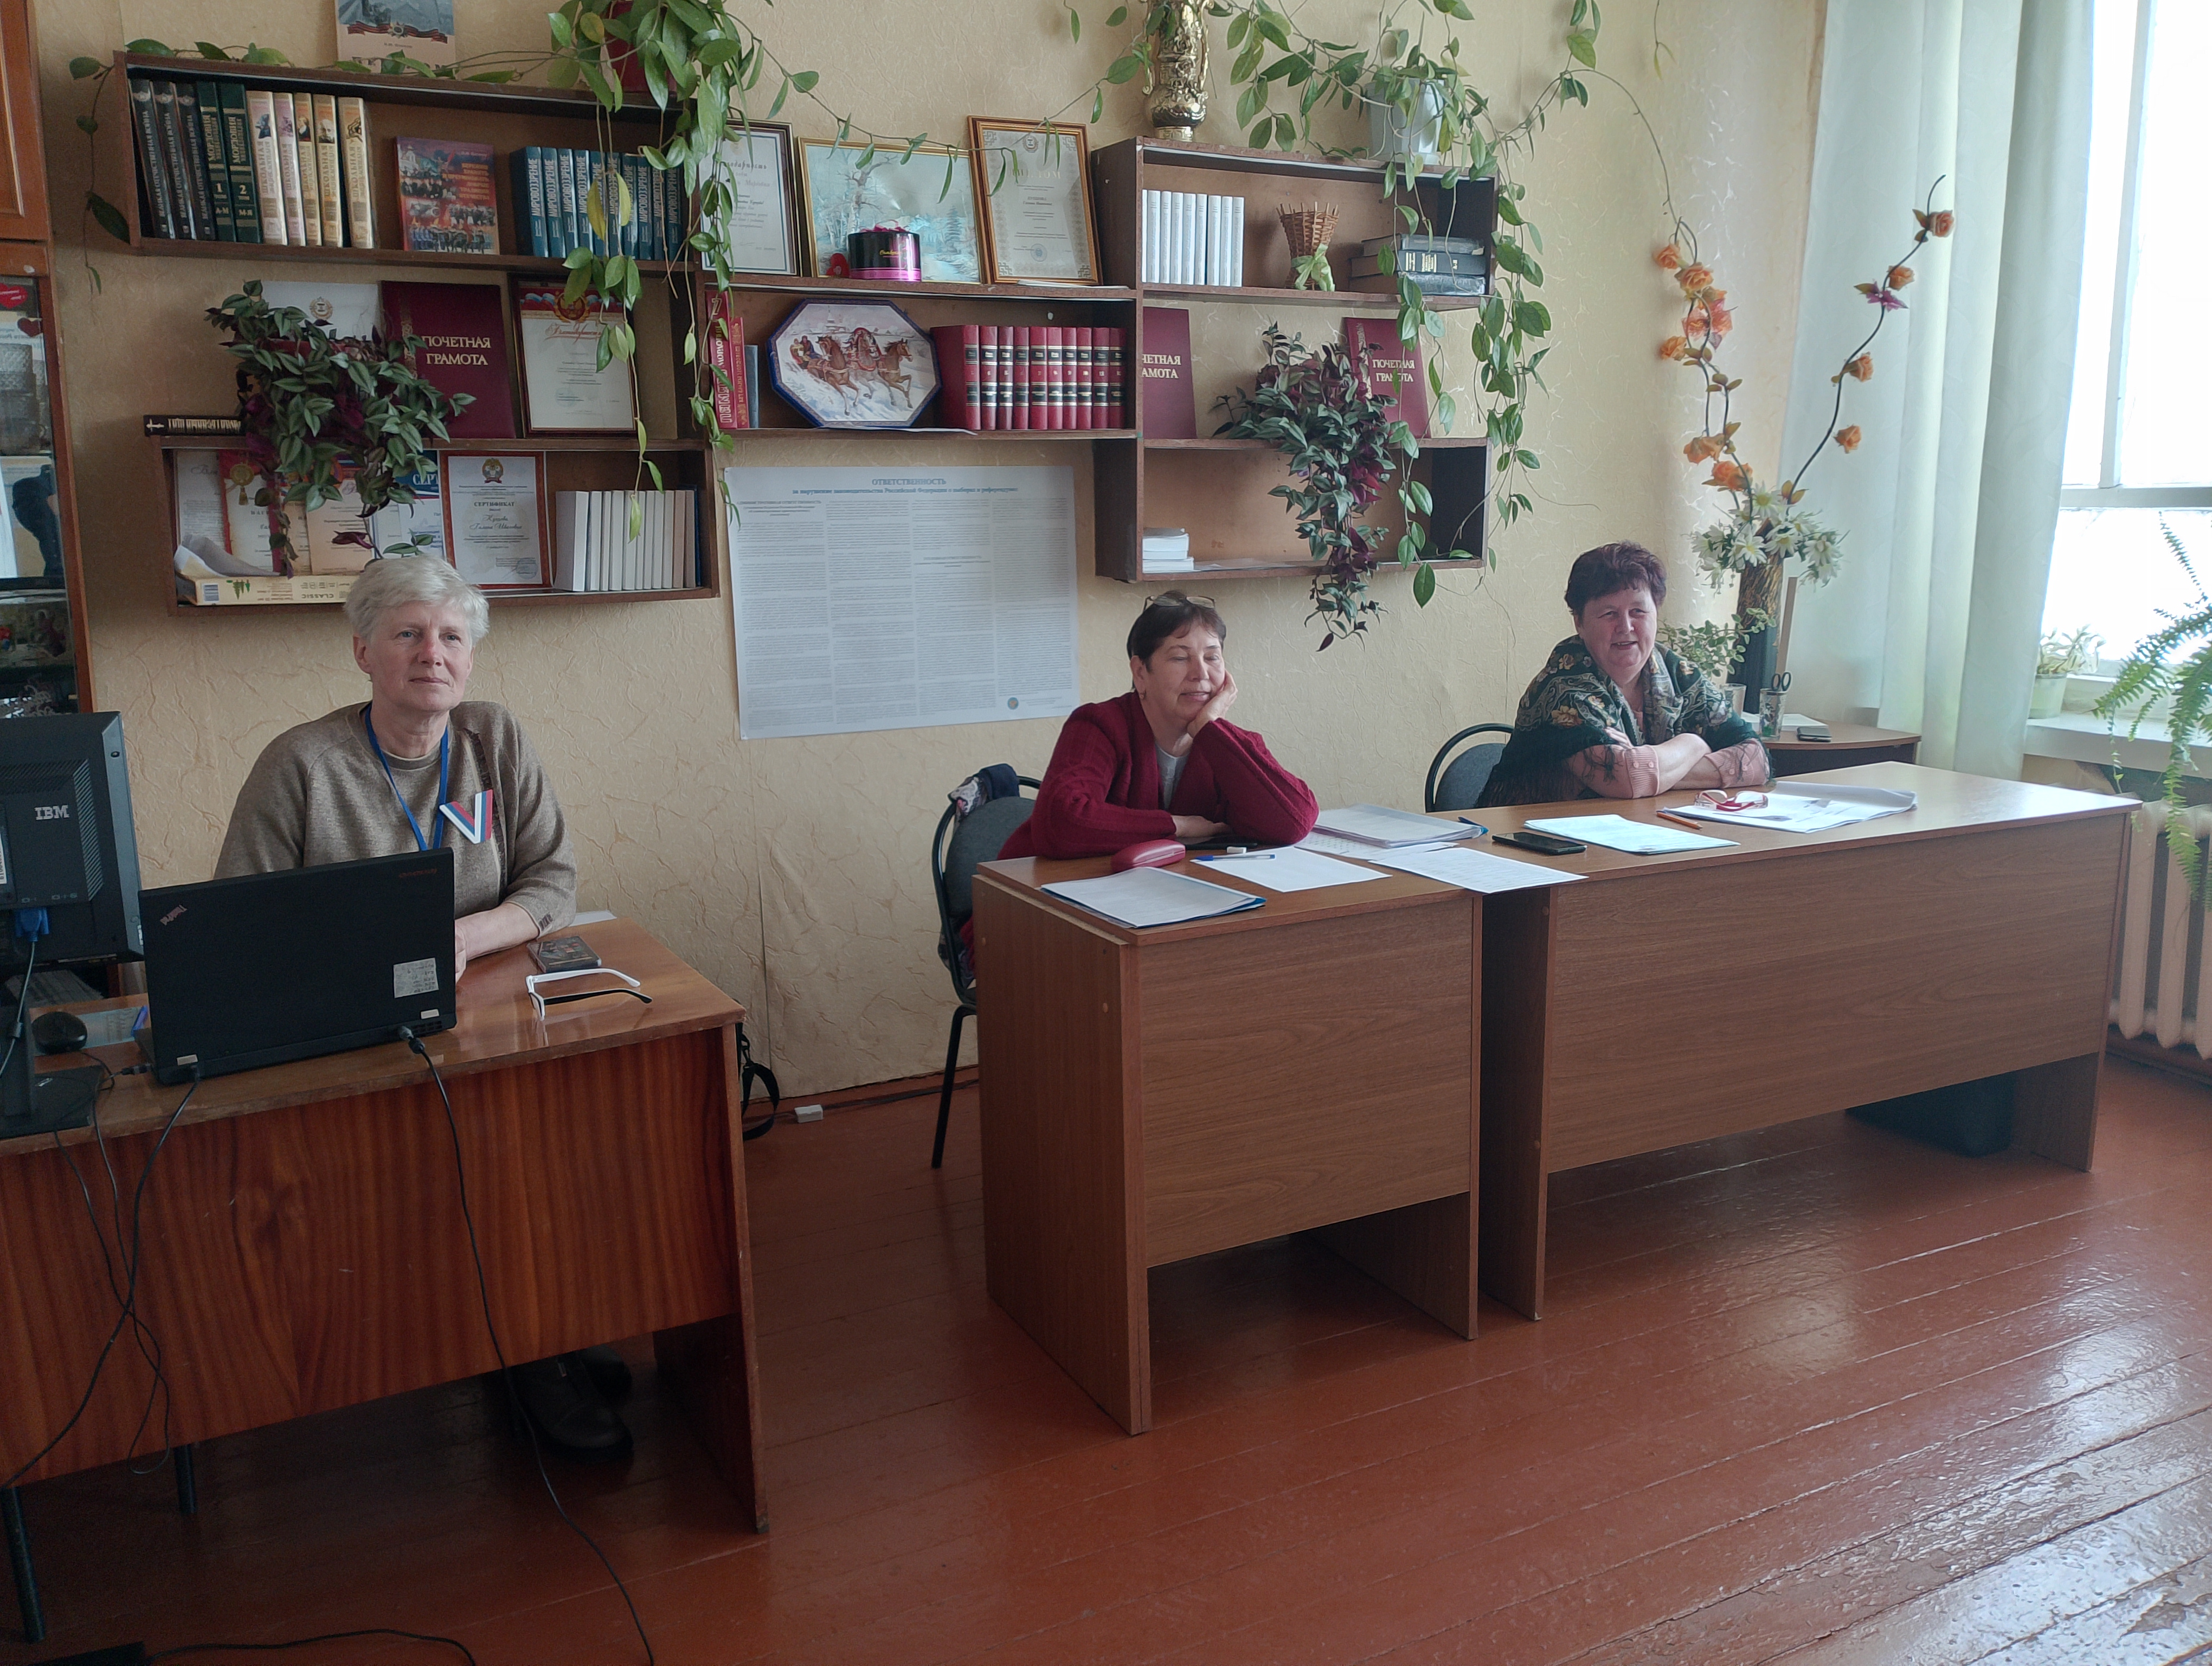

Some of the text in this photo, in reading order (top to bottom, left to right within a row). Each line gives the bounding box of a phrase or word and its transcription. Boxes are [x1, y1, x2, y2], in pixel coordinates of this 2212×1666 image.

[202, 114, 216, 162] МОРДОВИЯ
[228, 116, 241, 163] МОРДОВИЯ
[216, 183, 223, 193] 1
[240, 184, 247, 195] 2
[257, 140, 268, 194] ШКОЛЬНАЯ
[282, 143, 292, 190] ШКОЛЬНАЯ
[321, 145, 331, 197] ШКОЛЬНАЯ
[349, 146, 359, 198] ШКОЛЬНАЯ
[528, 157, 541, 216] МИРОВОЗЗРЕНИЕ
[544, 158, 558, 217] МИРОВОЗЗРЕНИЕ
[560, 154, 573, 213] МИРОВОЗЗРЕНИЕ
[638, 165, 648, 223] МИРОВОЗЗРЕНИЕ
[711, 298, 722, 315] 7
[421, 336, 491, 349] ПОЧЕТНАЯ
[426, 353, 488, 366] ГРАМОТА
[35, 805, 70, 821] IBM
